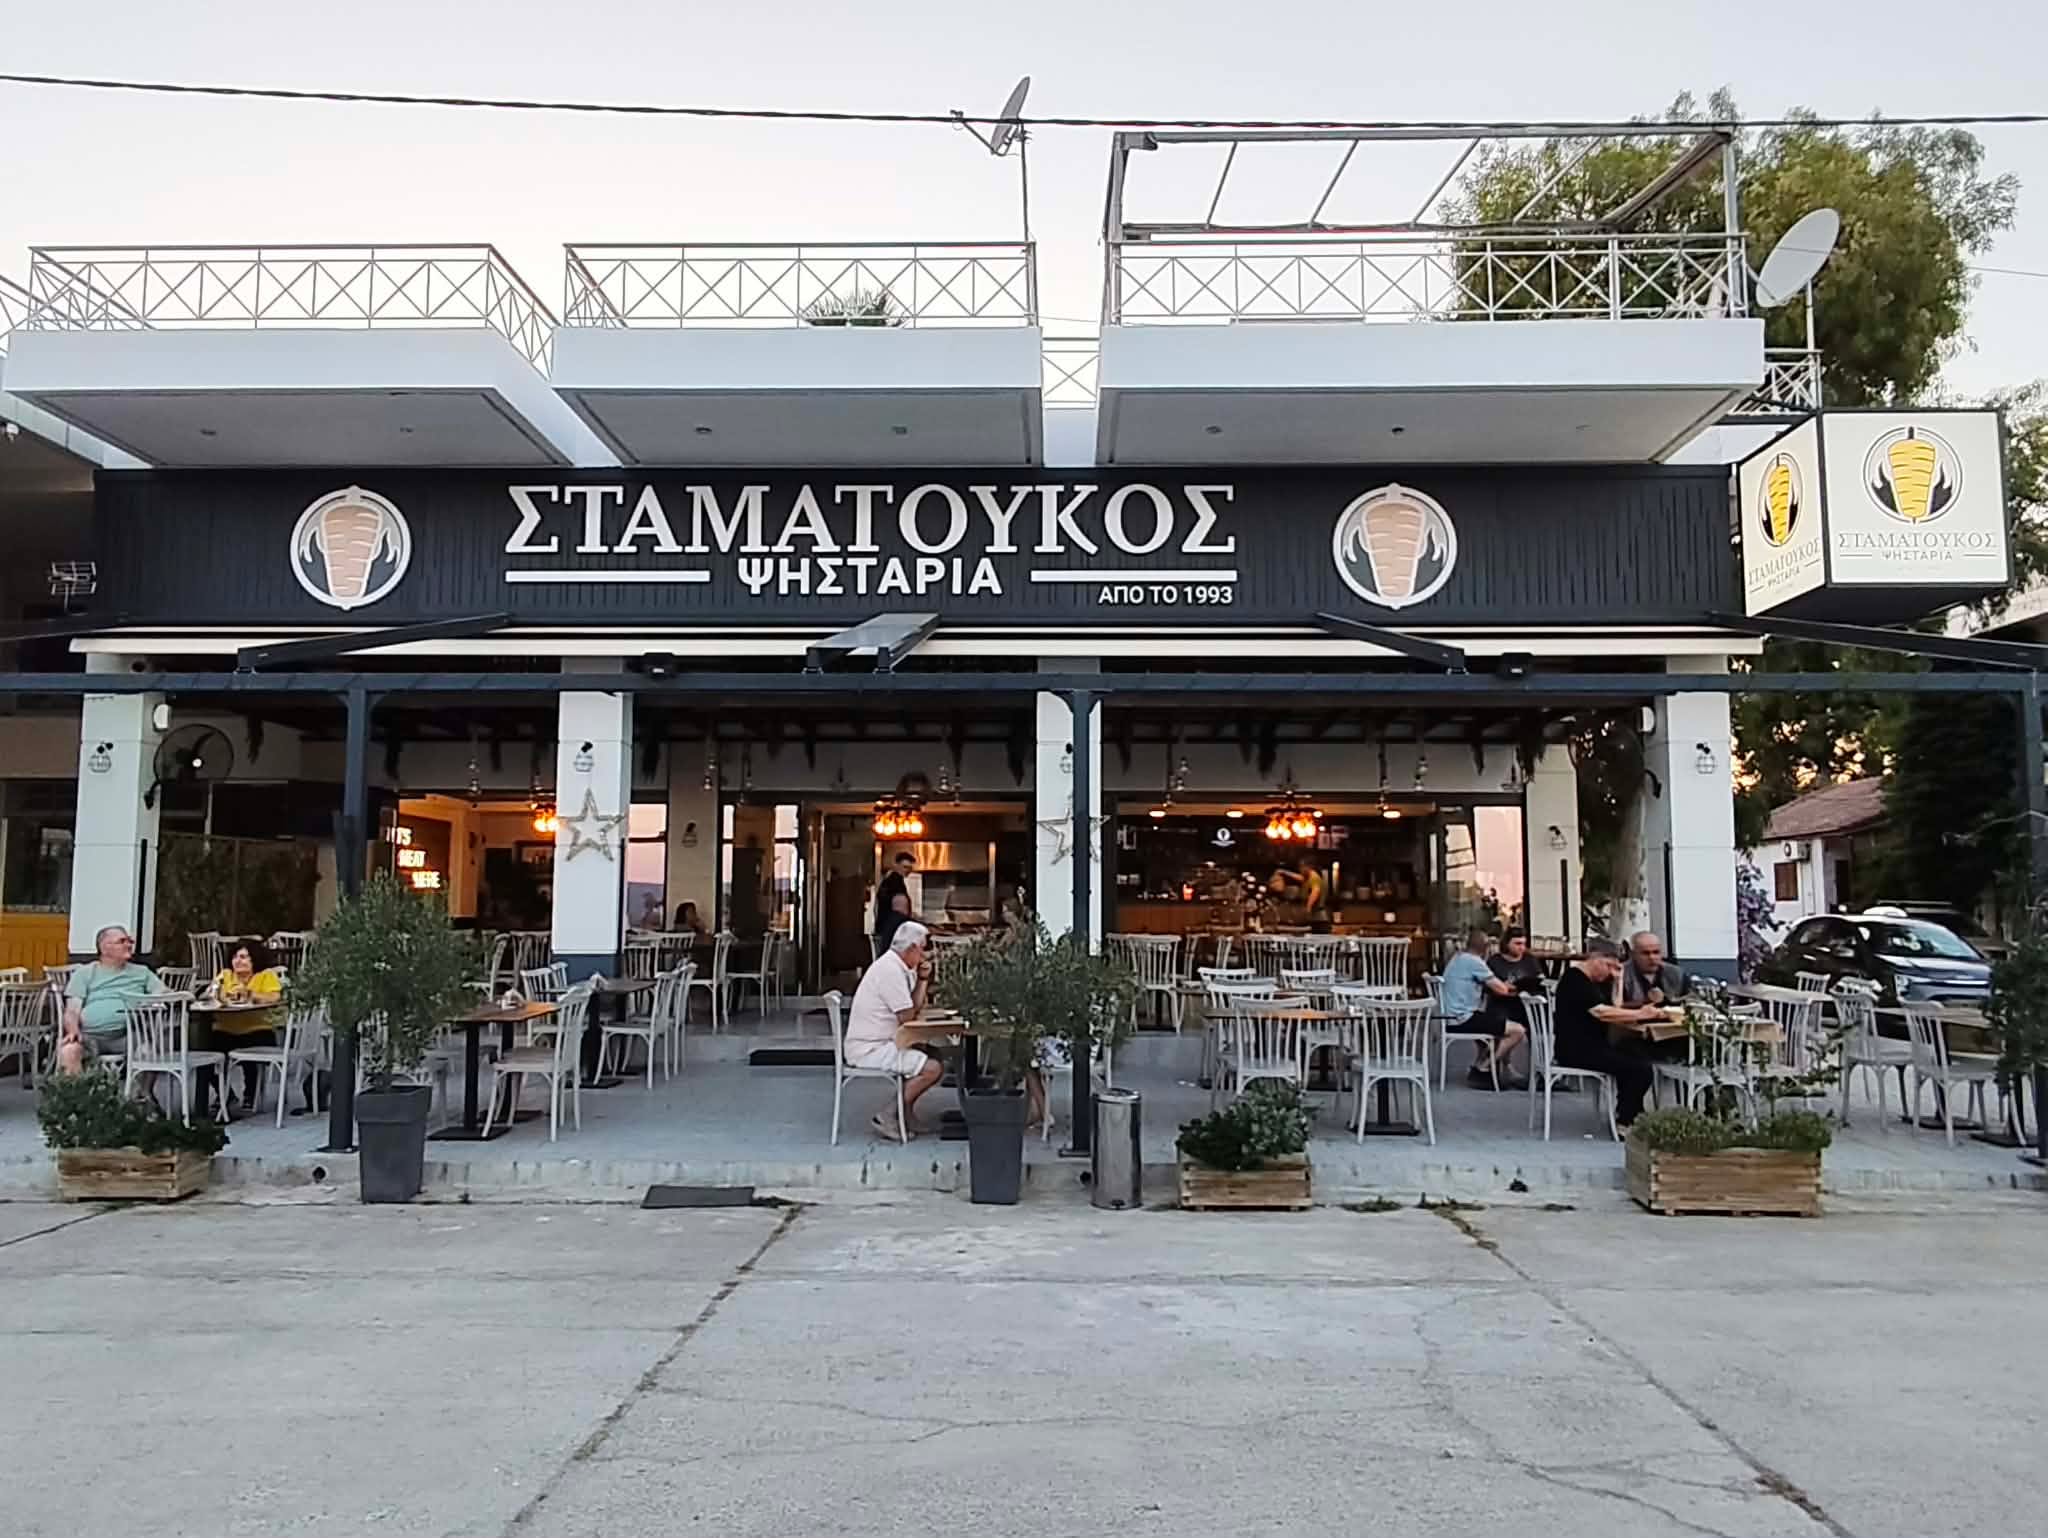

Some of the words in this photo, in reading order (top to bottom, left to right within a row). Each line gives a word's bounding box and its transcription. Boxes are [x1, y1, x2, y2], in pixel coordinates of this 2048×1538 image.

[505, 484, 1235, 555] ΣΤΑΜΑΤΟΥΚΟΣ
[1839, 532, 1998, 548] ΣΤΑΜΑΤΟΥΚΟΣ
[1882, 550, 1953, 561] ΨΗΣΤΑΡΙΑ
[738, 557, 1002, 595] ΨΗΣΤΑΡΙΑ
[1098, 585, 1144, 604] ΑΠΟ
[1149, 585, 1178, 604] ΤΟ
[1184, 585, 1233, 604] 1993
